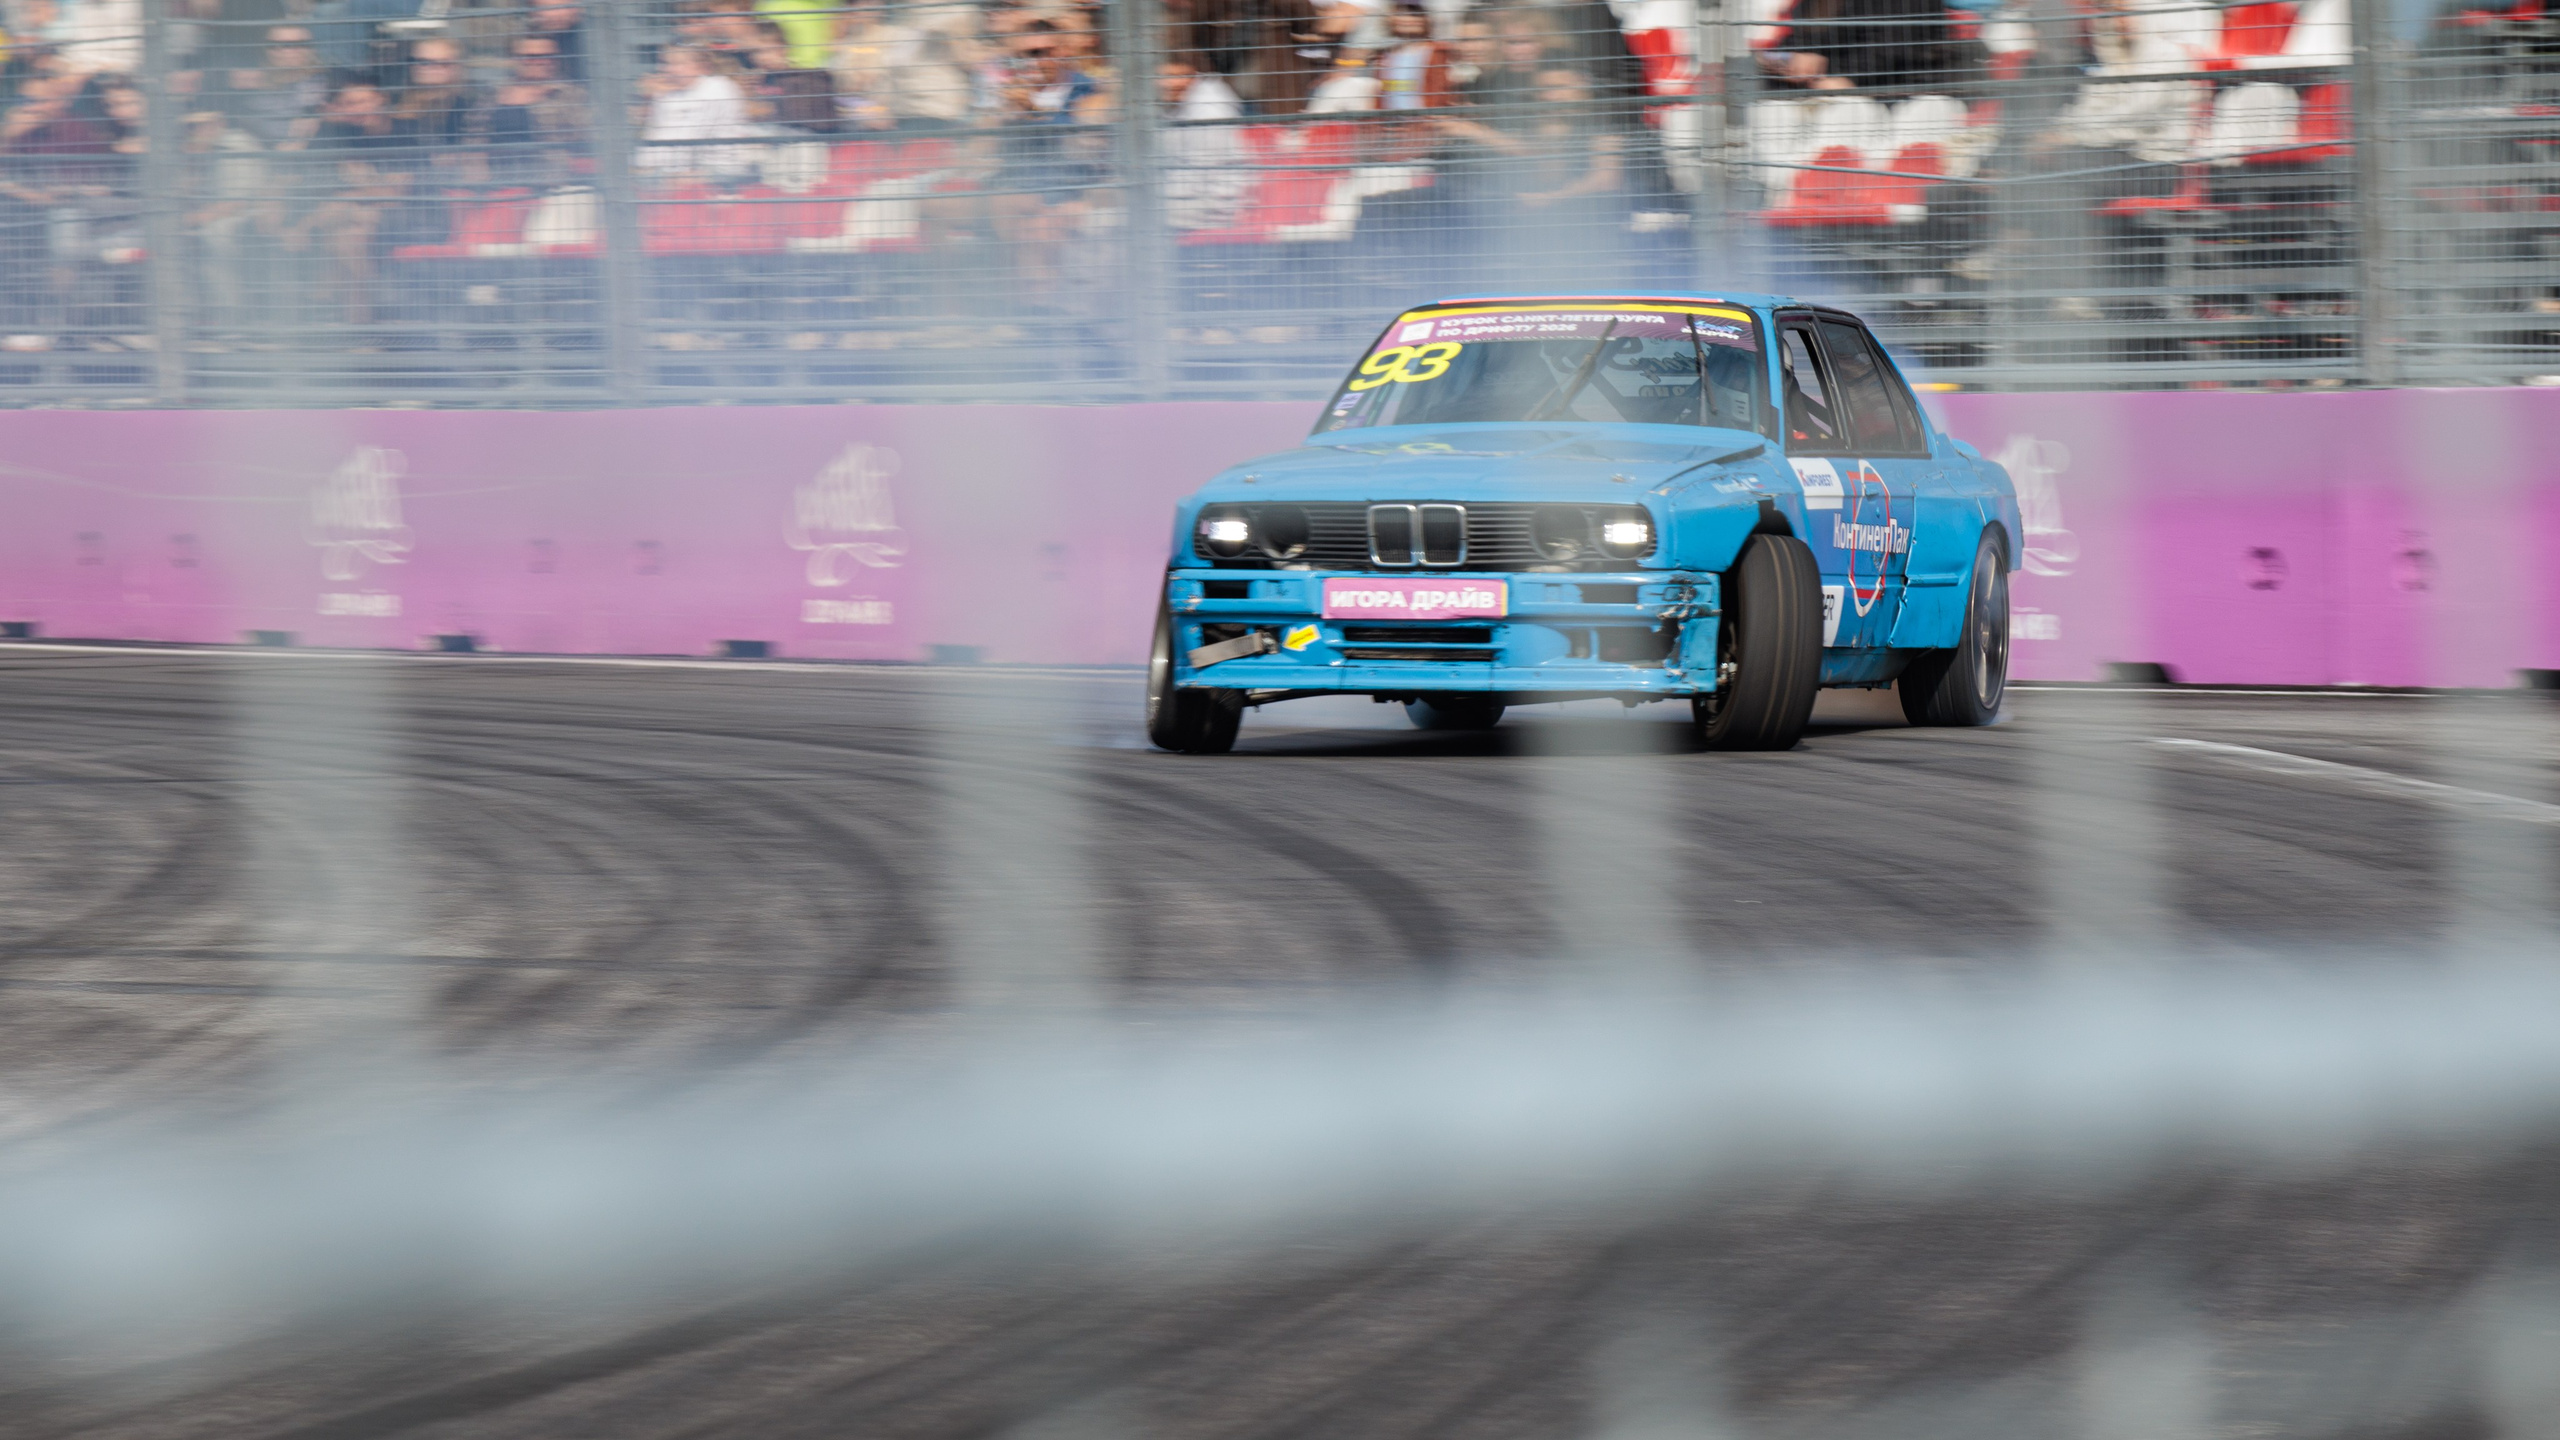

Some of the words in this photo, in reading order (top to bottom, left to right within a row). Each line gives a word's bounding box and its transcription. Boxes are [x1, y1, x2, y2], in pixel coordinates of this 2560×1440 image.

[1440, 316, 1497, 328] КУБОК
[1500, 314, 1665, 324] САНКТ-ПЕТЕРБУРГА
[1436, 328, 1460, 338] ПО
[1462, 325, 1534, 336] ДРИФТУ
[1537, 324, 1577, 332] 2026
[1349, 342, 1462, 392] 93
[1329, 590, 1408, 608] ИГОРА
[1409, 588, 1495, 611] ДРАЙВ
